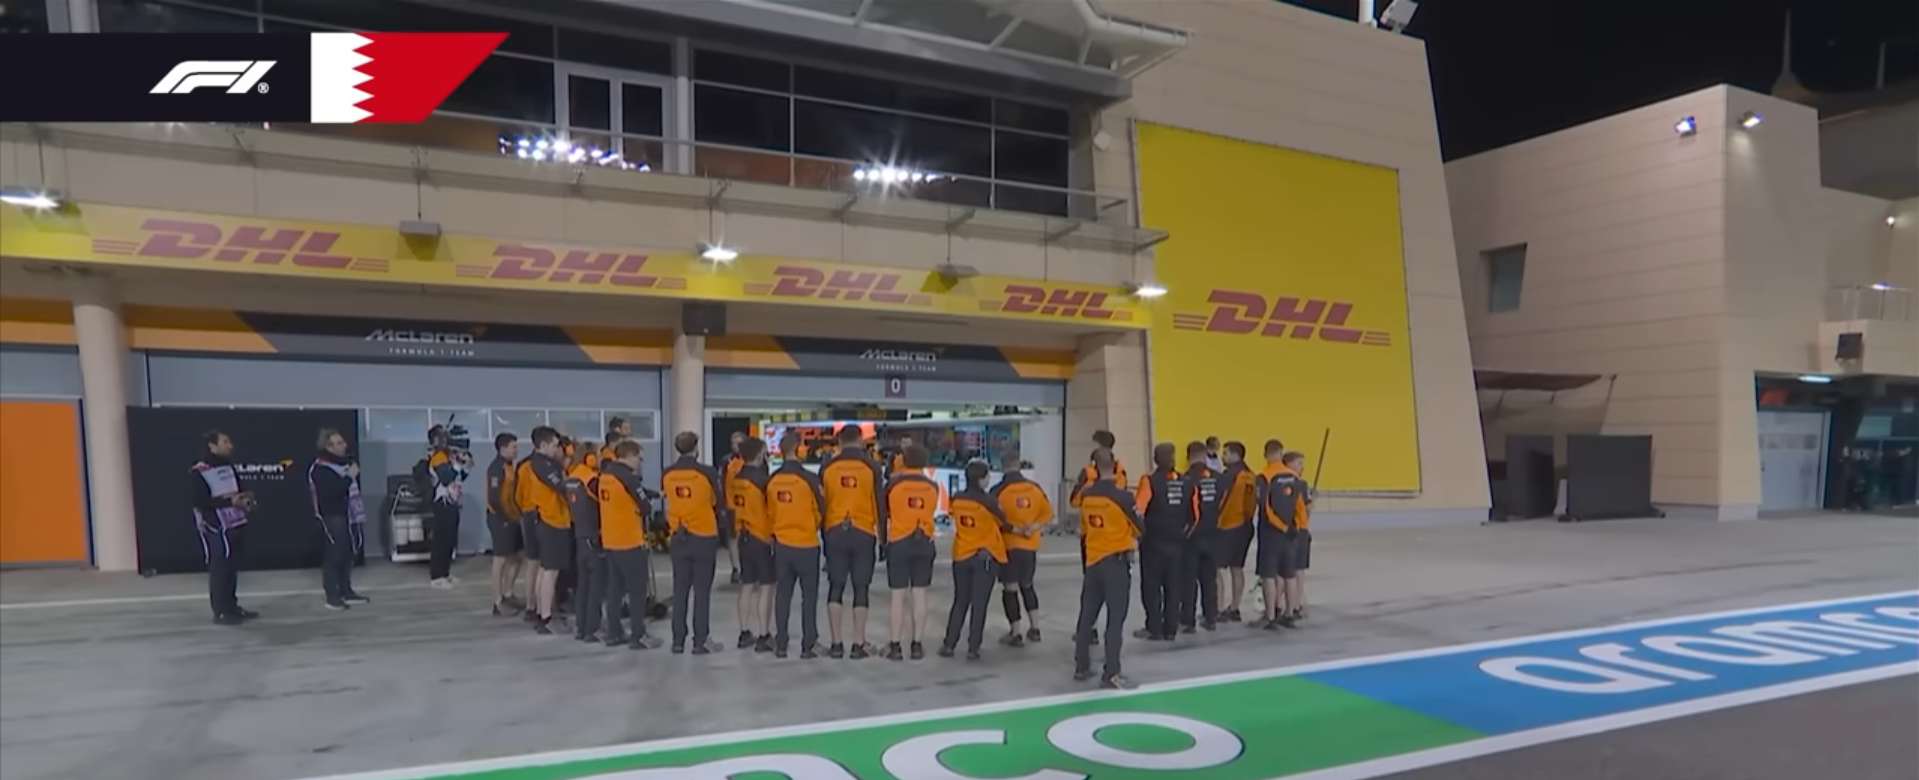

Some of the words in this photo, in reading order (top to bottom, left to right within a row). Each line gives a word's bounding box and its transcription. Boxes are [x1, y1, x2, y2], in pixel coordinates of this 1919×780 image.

[137, 218, 352, 270] DHL
[490, 244, 658, 287] DHL
[771, 265, 908, 304] DHL
[1002, 284, 1114, 320] DHL
[1206, 289, 1363, 344] DHL
[364, 328, 474, 345] McLaren
[859, 348, 937, 362] McLaren
